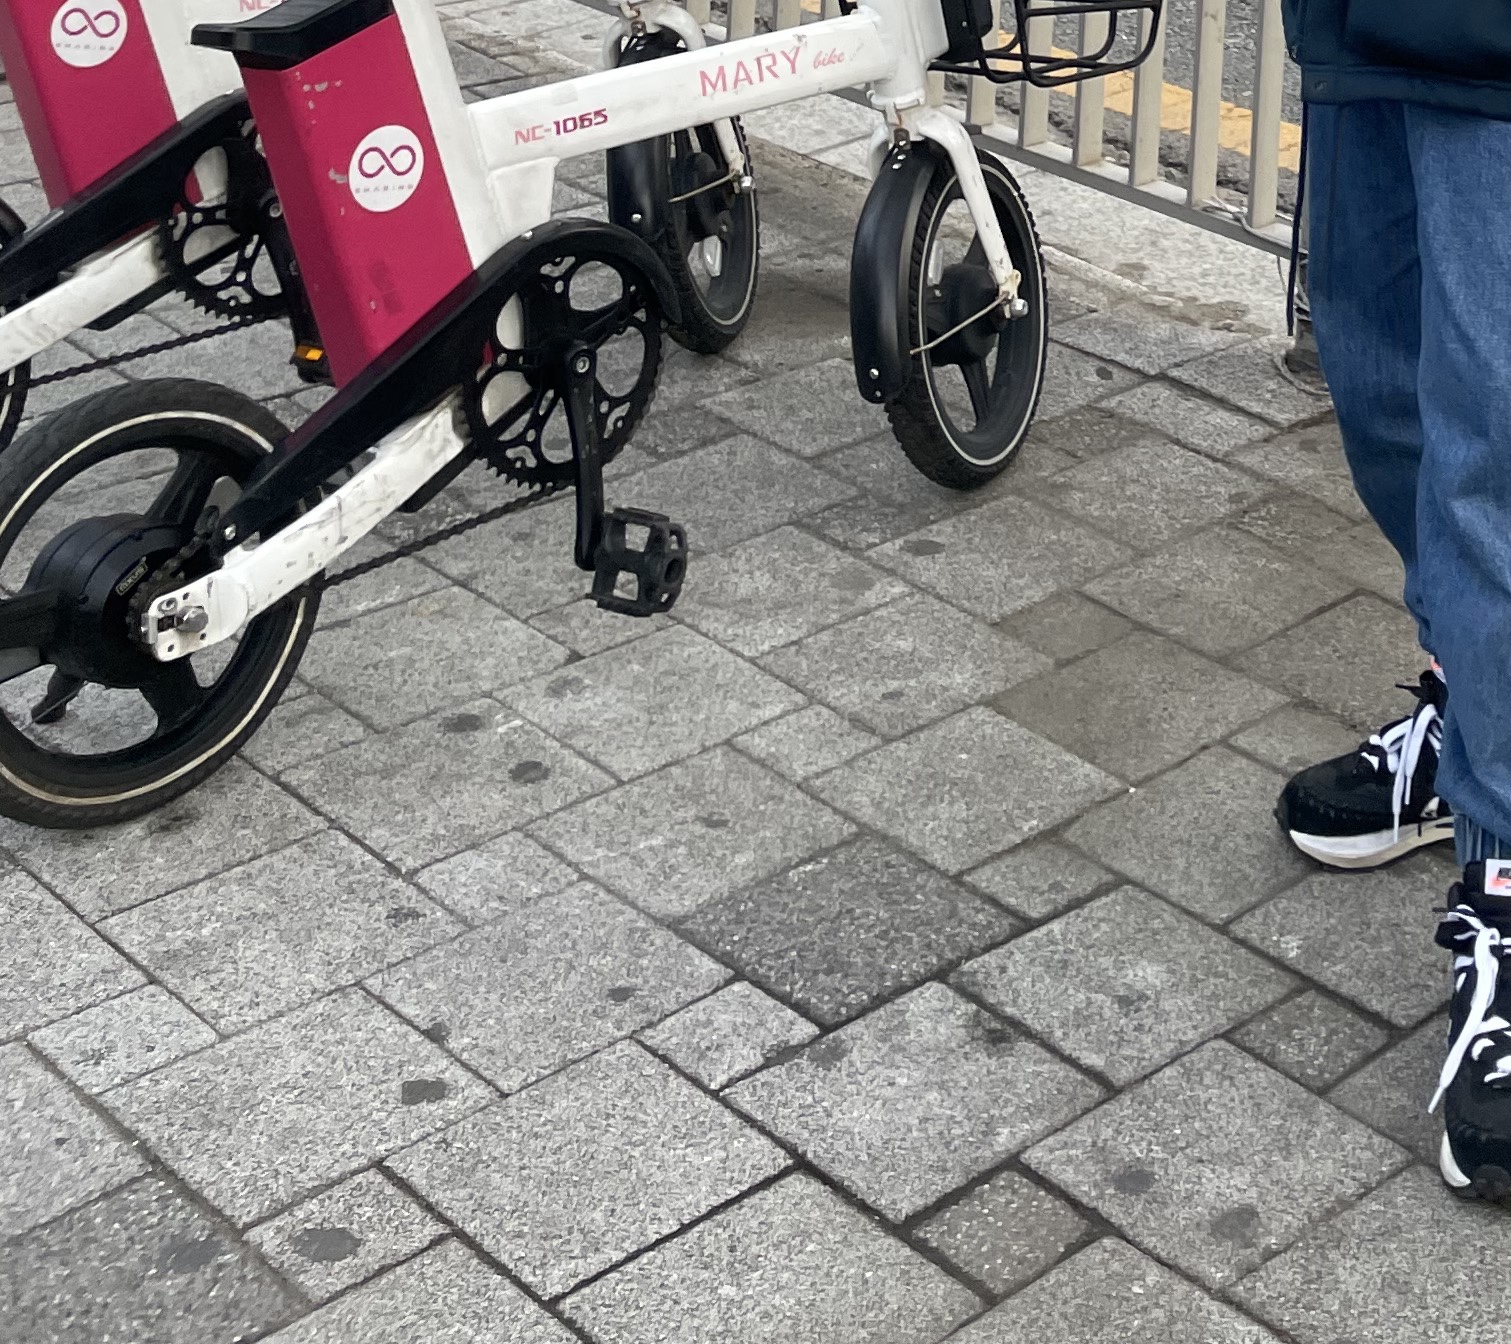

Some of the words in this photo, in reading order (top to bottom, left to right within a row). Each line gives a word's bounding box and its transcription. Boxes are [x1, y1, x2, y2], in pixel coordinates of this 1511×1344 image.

[698, 47, 803, 97] MARY
[812, 50, 846, 70] bike
[514, 108, 609, 146] NC-1065
